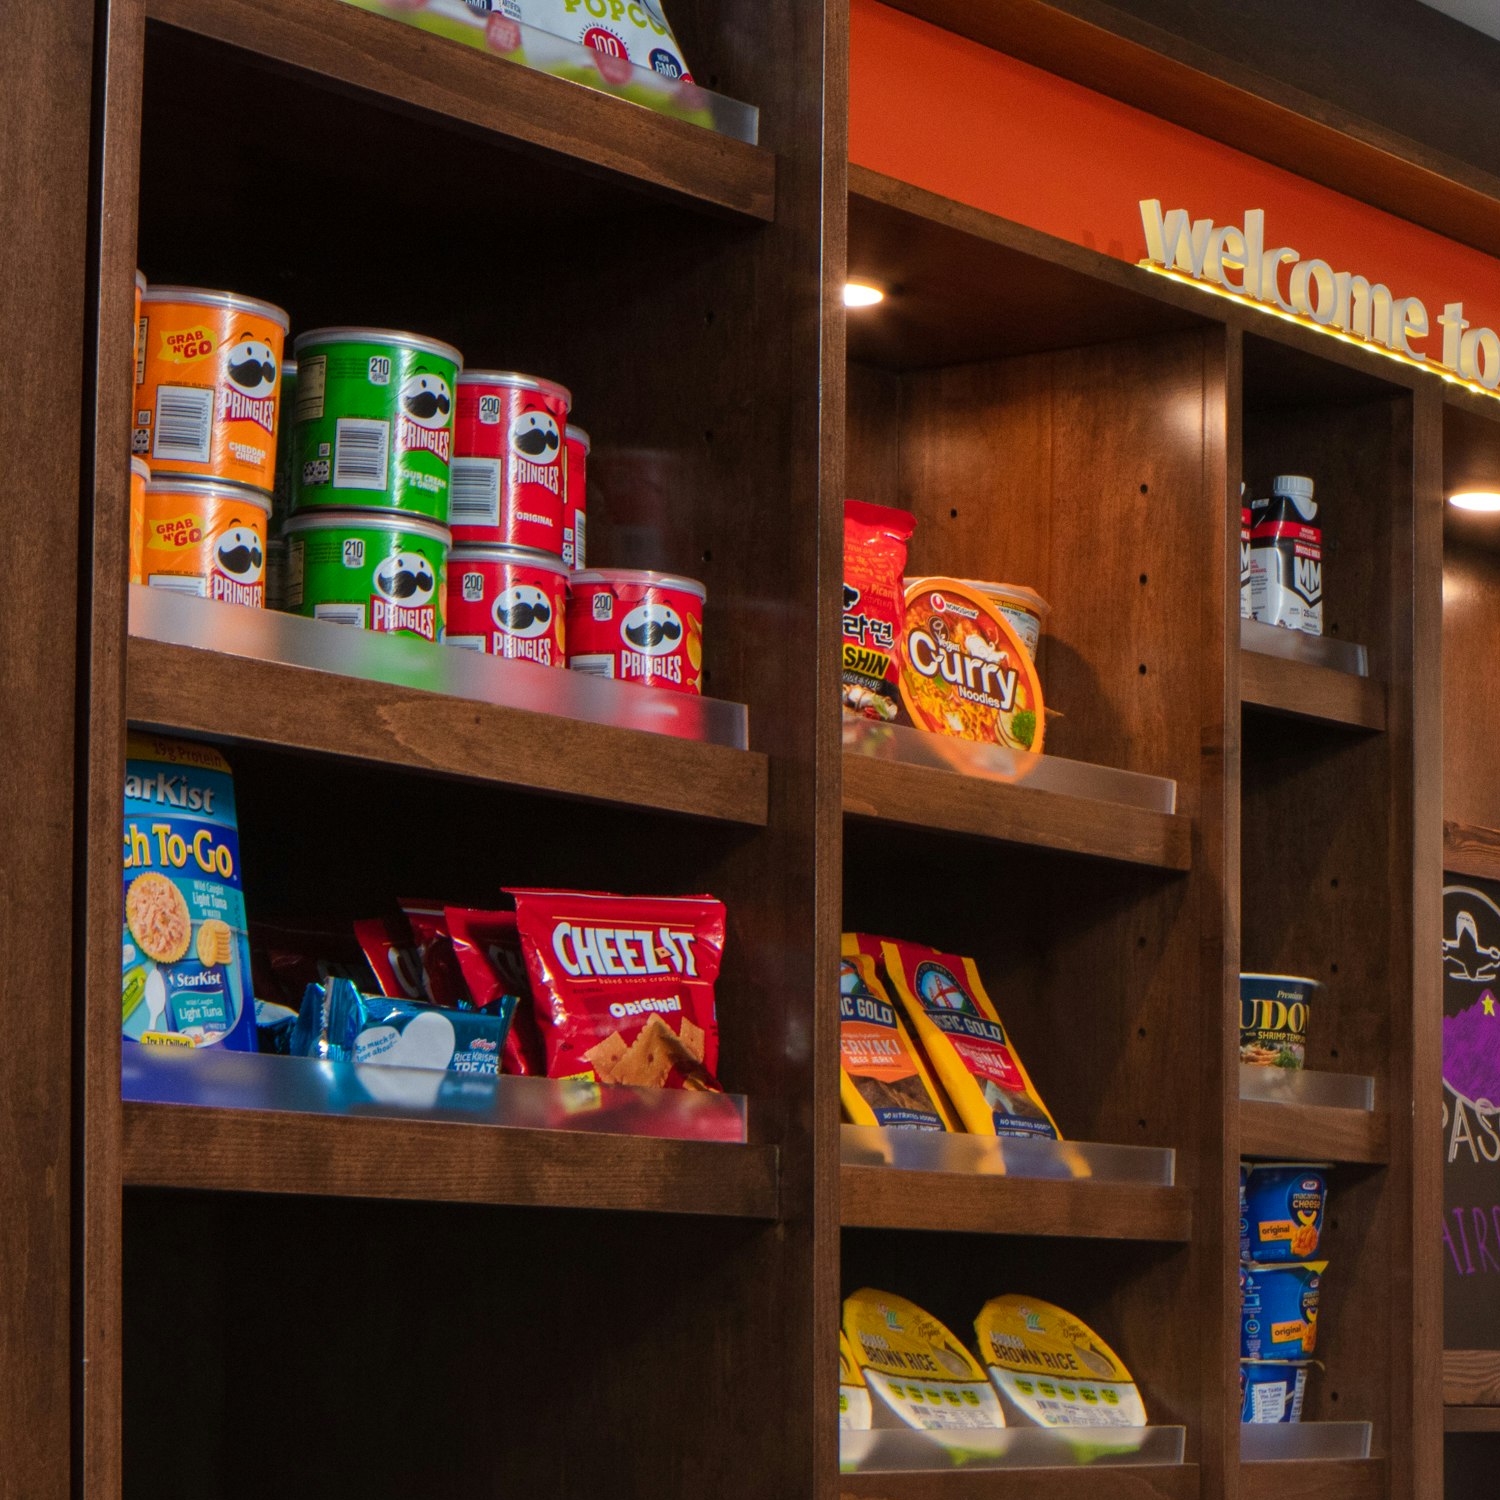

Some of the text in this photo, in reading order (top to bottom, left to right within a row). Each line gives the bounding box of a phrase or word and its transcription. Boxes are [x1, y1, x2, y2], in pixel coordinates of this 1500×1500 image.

[1139, 199, 1429, 361] welcome
[166, 330, 204, 347] GRAB
[183, 340, 212, 359] GO
[370, 357, 389, 375] 210
[221, 389, 275, 433] PRINGLES
[481, 397, 500, 415] 200
[228, 442, 266, 459] CHEDDAR
[235, 452, 262, 465] CHEESE
[420, 472, 447, 488] CREAM
[511, 457, 559, 495] PRINGLES
[156, 518, 193, 534] GRAB
[516, 511, 554, 527] ORIGINAL
[173, 528, 202, 547] GO
[344, 539, 364, 558] 210
[213, 574, 264, 608] PRINGLES
[464, 574, 483, 592] 200
[594, 594, 613, 611] 200
[373, 599, 434, 639] PRINGLES
[493, 630, 551, 667] PRINGLES
[620, 649, 682, 684] PRINGLES
[844, 645, 889, 678] SHIN
[909, 630, 1017, 711] Curry
[959, 685, 1000, 708] Noodles
[124, 772, 215, 815] arKist
[151, 822, 234, 879] To-Go
[176, 971, 222, 988] StarKist
[179, 1005, 224, 1023] Light Tuna
[857, 998, 894, 1025] GOLD
[966, 1018, 1002, 1041] GOLD
[1257, 1031, 1287, 1042] SHRIMP
[841, 1039, 902, 1055] ERIYAKI
[1261, 1224, 1291, 1236] original
[1274, 1324, 1302, 1338] original
[862, 1345, 939, 1372] BROWN RICE
[992, 1342, 1079, 1371] BROWN RICE
